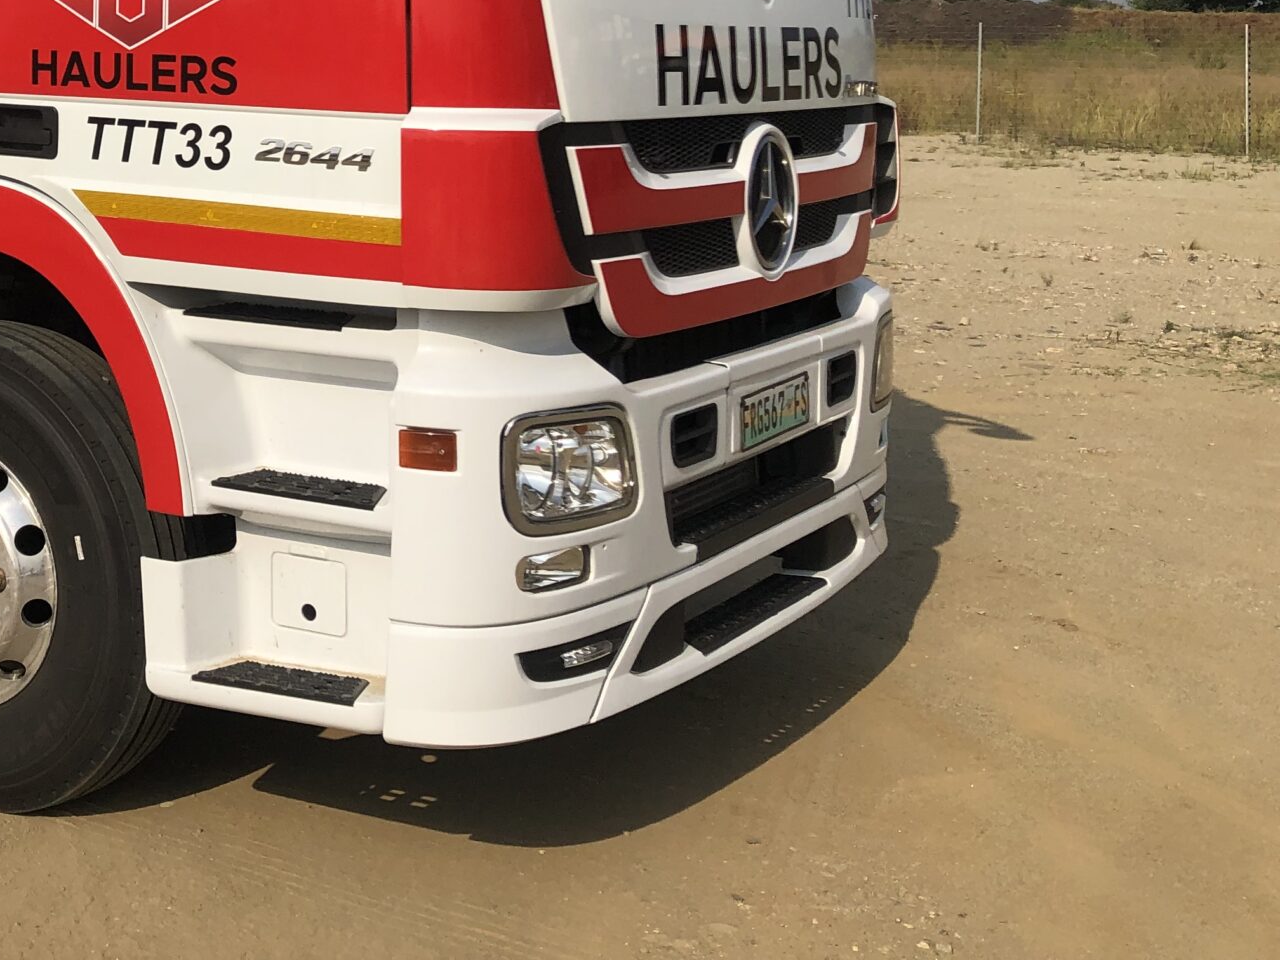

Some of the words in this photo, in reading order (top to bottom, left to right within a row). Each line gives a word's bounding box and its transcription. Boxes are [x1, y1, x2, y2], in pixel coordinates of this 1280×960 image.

[31, 49, 239, 96] HAULERS
[654, 23, 843, 107] HAULERS
[87, 116, 233, 171] TTT33
[255, 138, 376, 172] 2644
